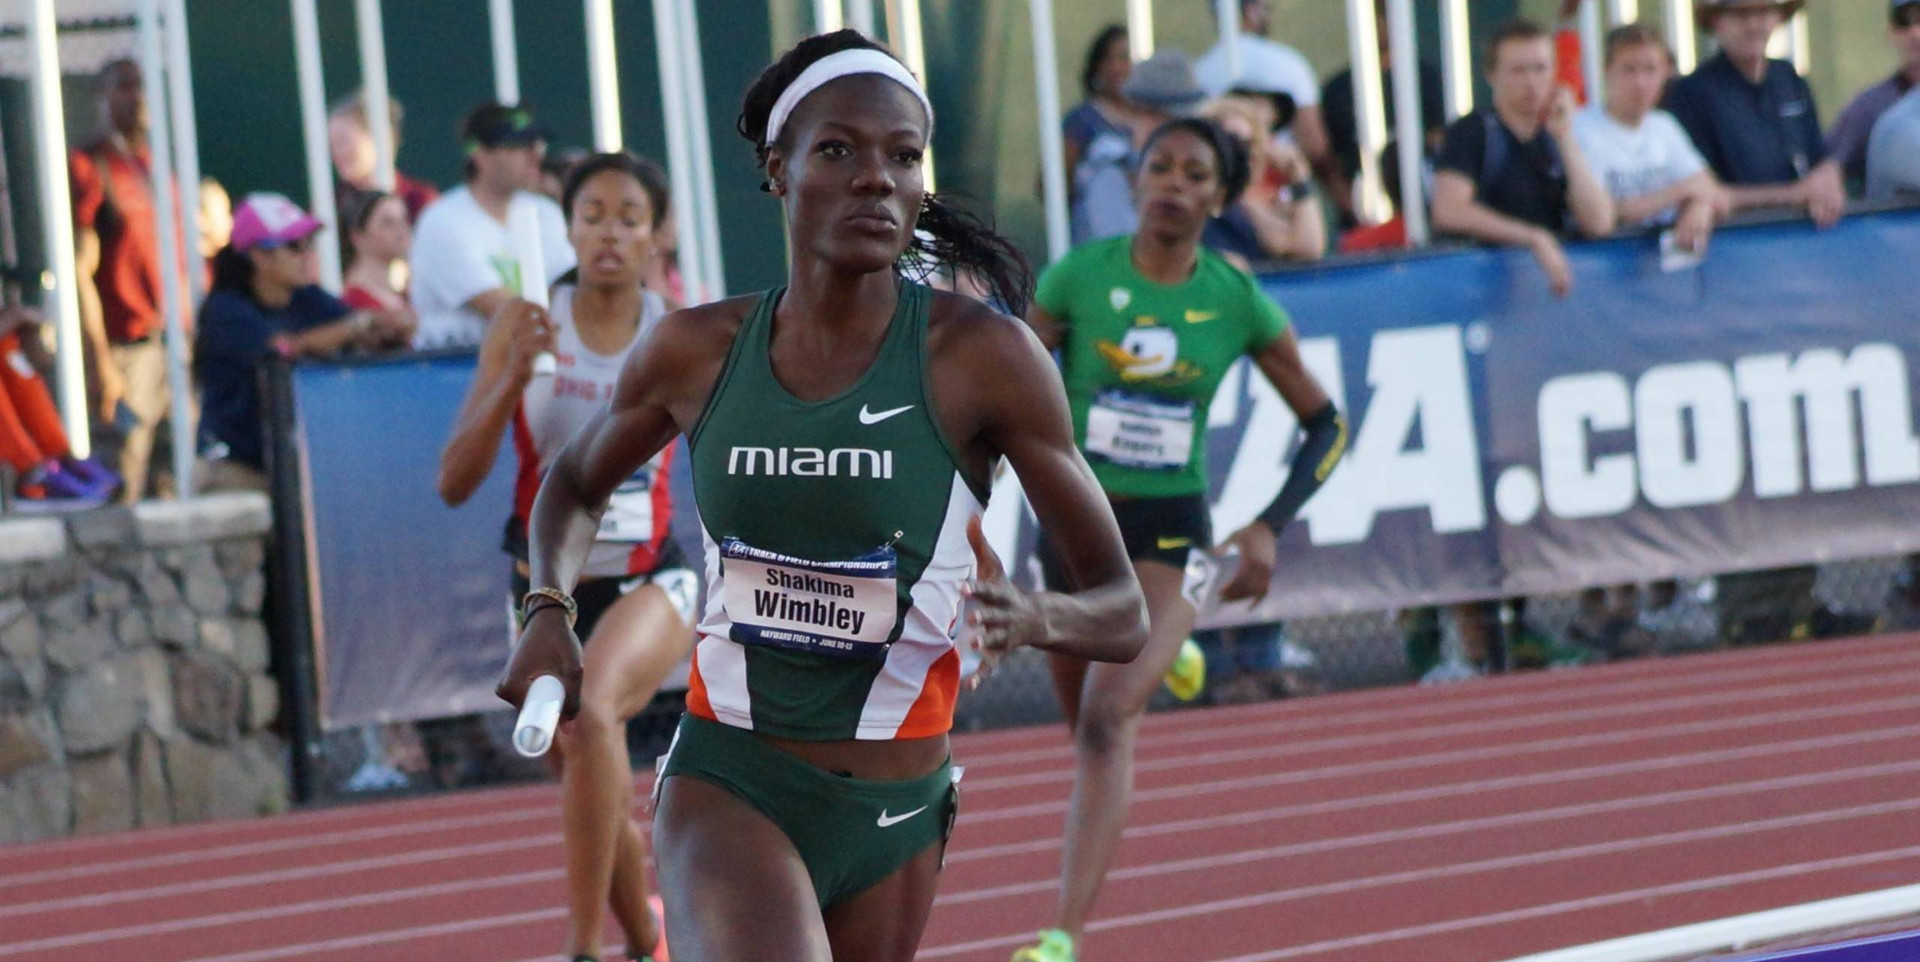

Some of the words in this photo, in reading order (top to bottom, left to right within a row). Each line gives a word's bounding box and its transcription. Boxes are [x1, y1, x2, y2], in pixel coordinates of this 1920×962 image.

[766, 568, 855, 599] Shakima
[754, 589, 866, 635] Wimbley
[760, 629, 792, 641] HAYWARD
[792, 633, 811, 644] FIELD
[818, 638, 836, 648] JUNE
